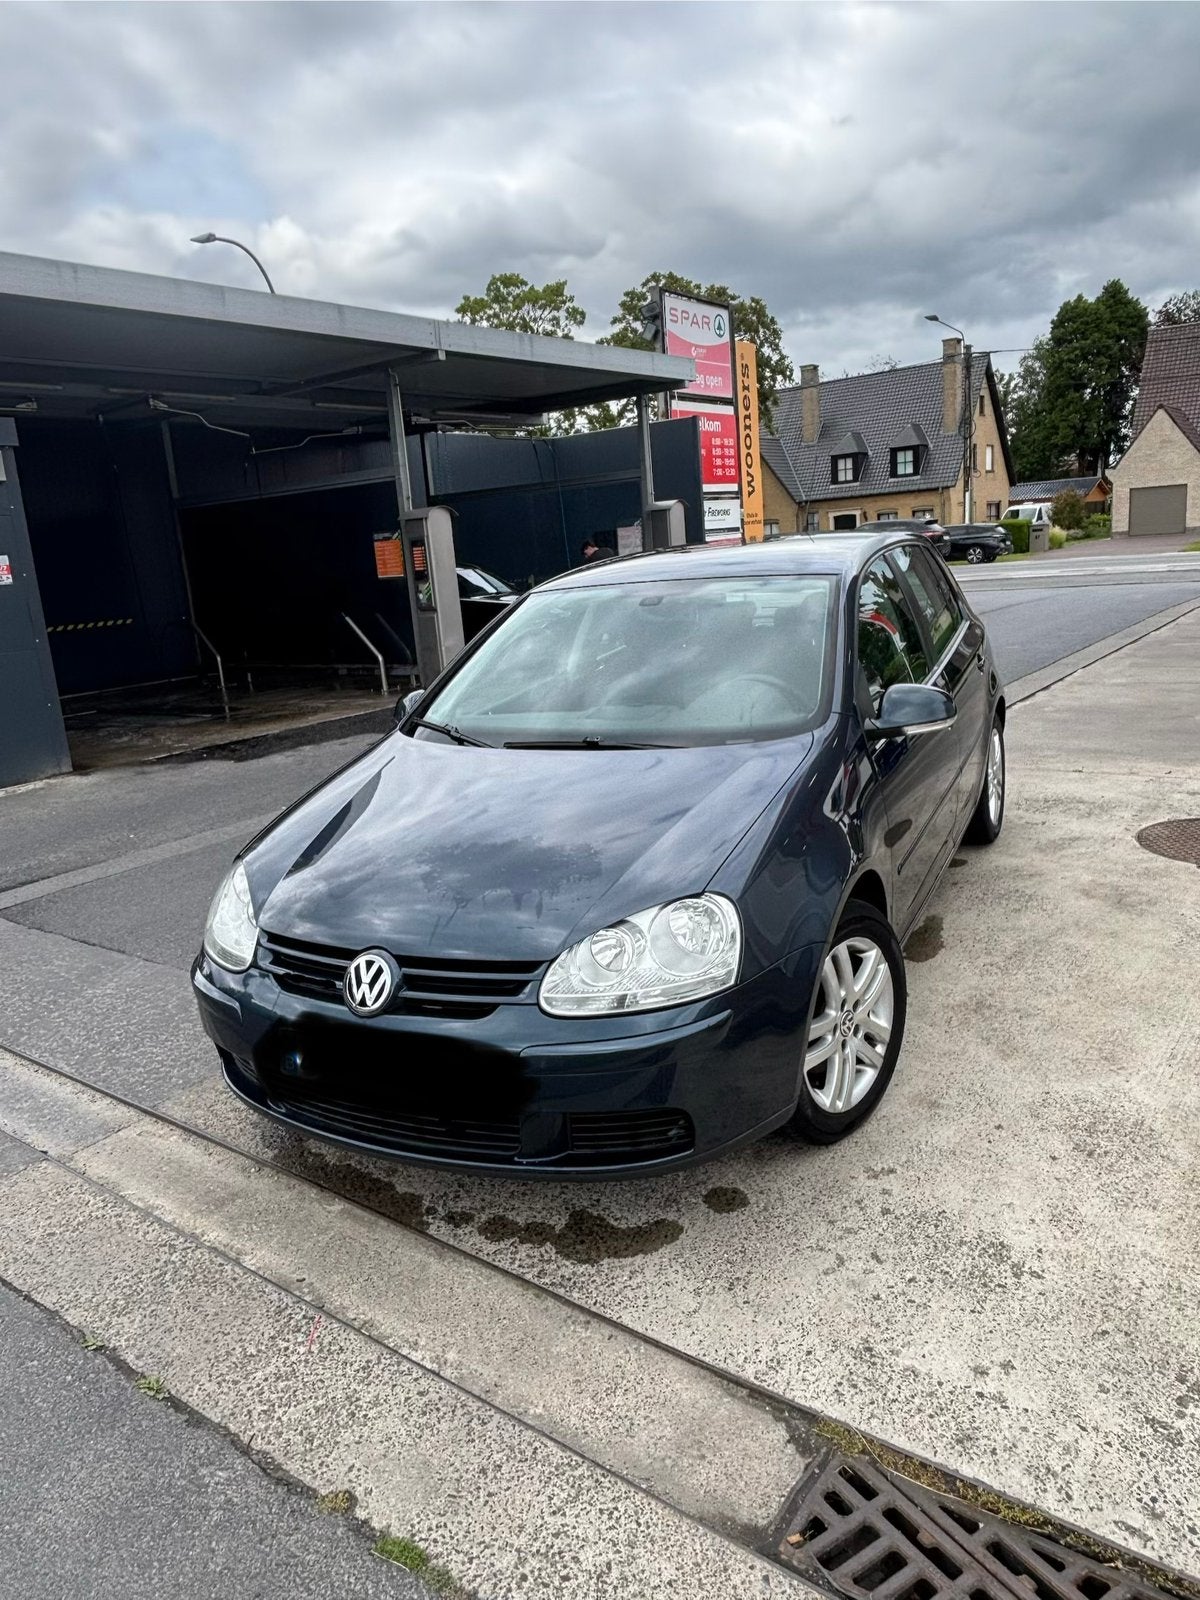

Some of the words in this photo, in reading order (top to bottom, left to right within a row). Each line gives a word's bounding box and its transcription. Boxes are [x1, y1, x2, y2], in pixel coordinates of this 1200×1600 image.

[669, 307, 711, 331] SPAR
[705, 375, 723, 389] open
[740, 363, 756, 498] wooners
[347, 955, 392, 1009] VW
